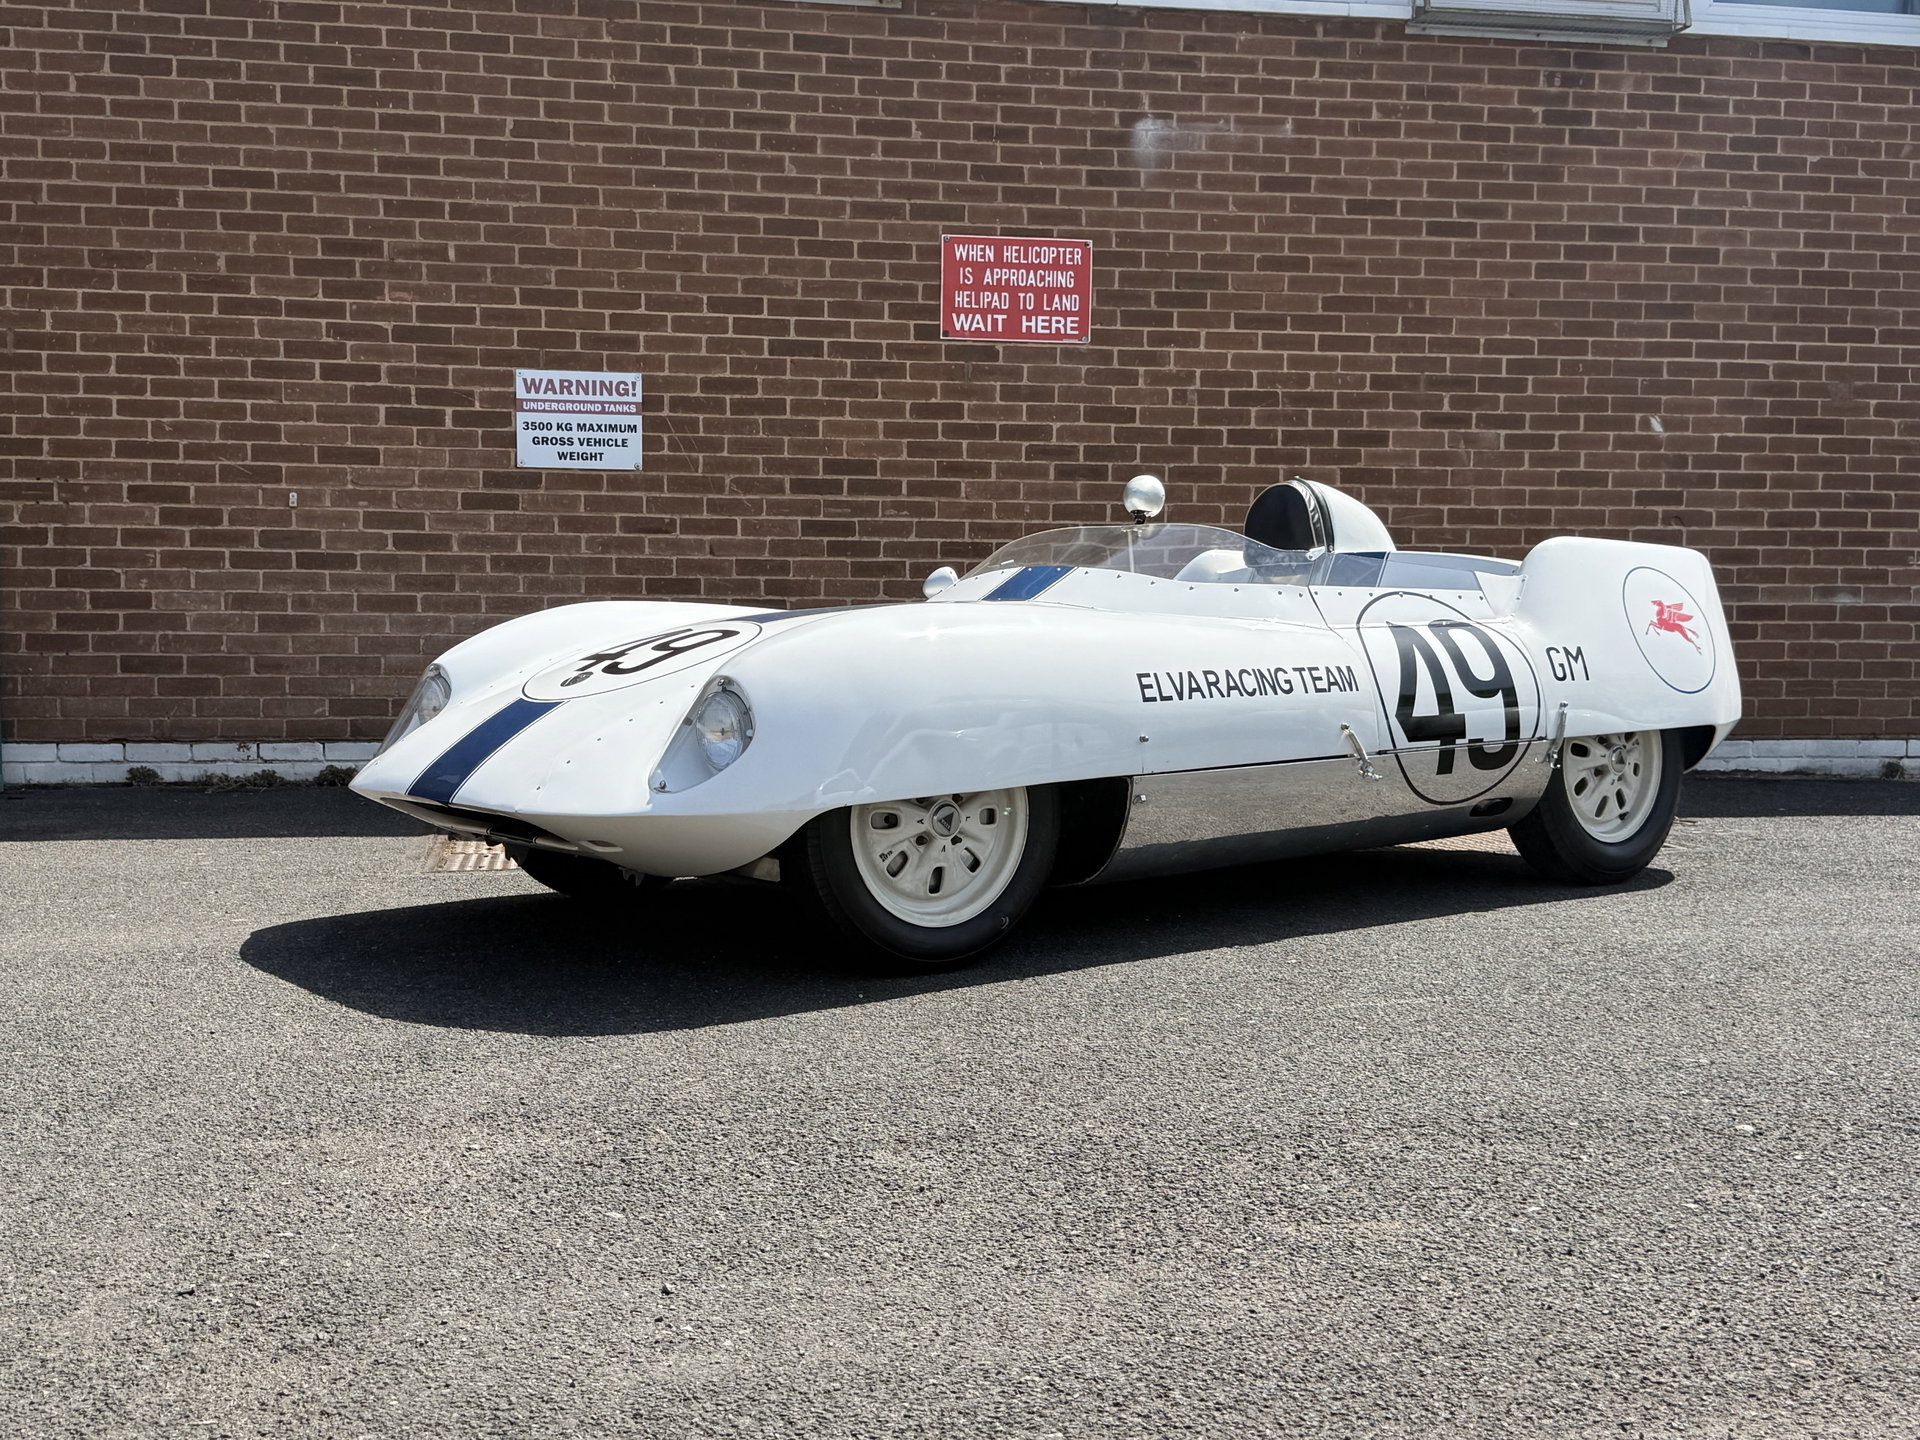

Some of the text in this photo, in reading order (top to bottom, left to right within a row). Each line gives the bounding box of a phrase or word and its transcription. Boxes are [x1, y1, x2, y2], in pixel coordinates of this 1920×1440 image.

[954, 244, 1082, 265] WHEN HELICOPTER
[959, 267, 1075, 288] IS APPROACHING
[954, 290, 1079, 311] HELIPAD TO LAND
[952, 312, 1079, 335] WAIT HERE
[522, 377, 637, 397] WARNING!
[522, 401, 637, 413] UNDERGROUND TANKS
[522, 421, 638, 434] 3500 KG MAXIMUM
[531, 436, 629, 448] GROSS VEHICLE
[557, 451, 605, 462] WEIGHT
[576, 628, 740, 675] 49
[1545, 645, 1590, 682] GM
[1293, 665, 1360, 694] TEAM
[1387, 619, 1521, 776] 49
